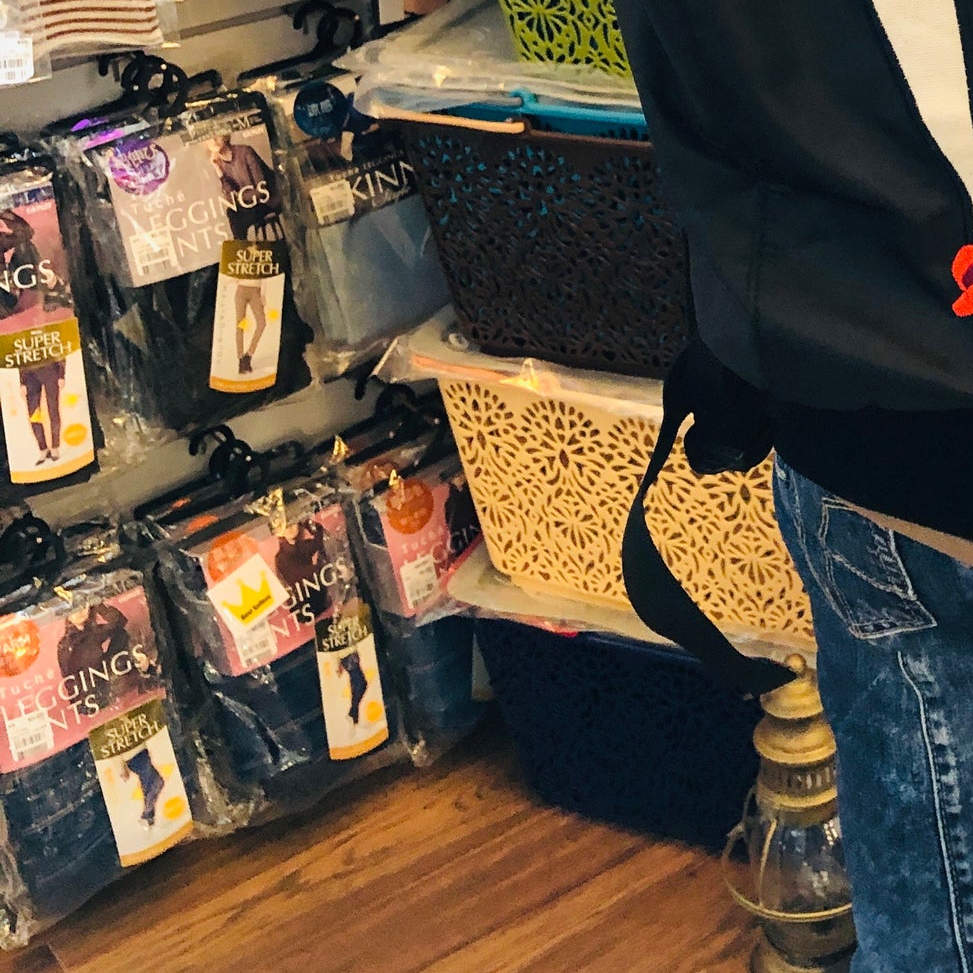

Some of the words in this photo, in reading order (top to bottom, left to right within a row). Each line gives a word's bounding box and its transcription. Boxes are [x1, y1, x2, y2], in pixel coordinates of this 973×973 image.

[352, 161, 415, 201] KINN
[176, 223, 228, 258] NTS
[236, 249, 273, 263] SUPER
[227, 262, 280, 275] STRETCH
[5, 341, 72, 368] STRETCH
[13, 331, 61, 353] SUPER
[282, 557, 352, 610] GINGS
[268, 604, 315, 638] NTS
[49, 694, 100, 732] NTS
[107, 713, 148, 741] SUPER
[101, 721, 160, 757] STRETCH
